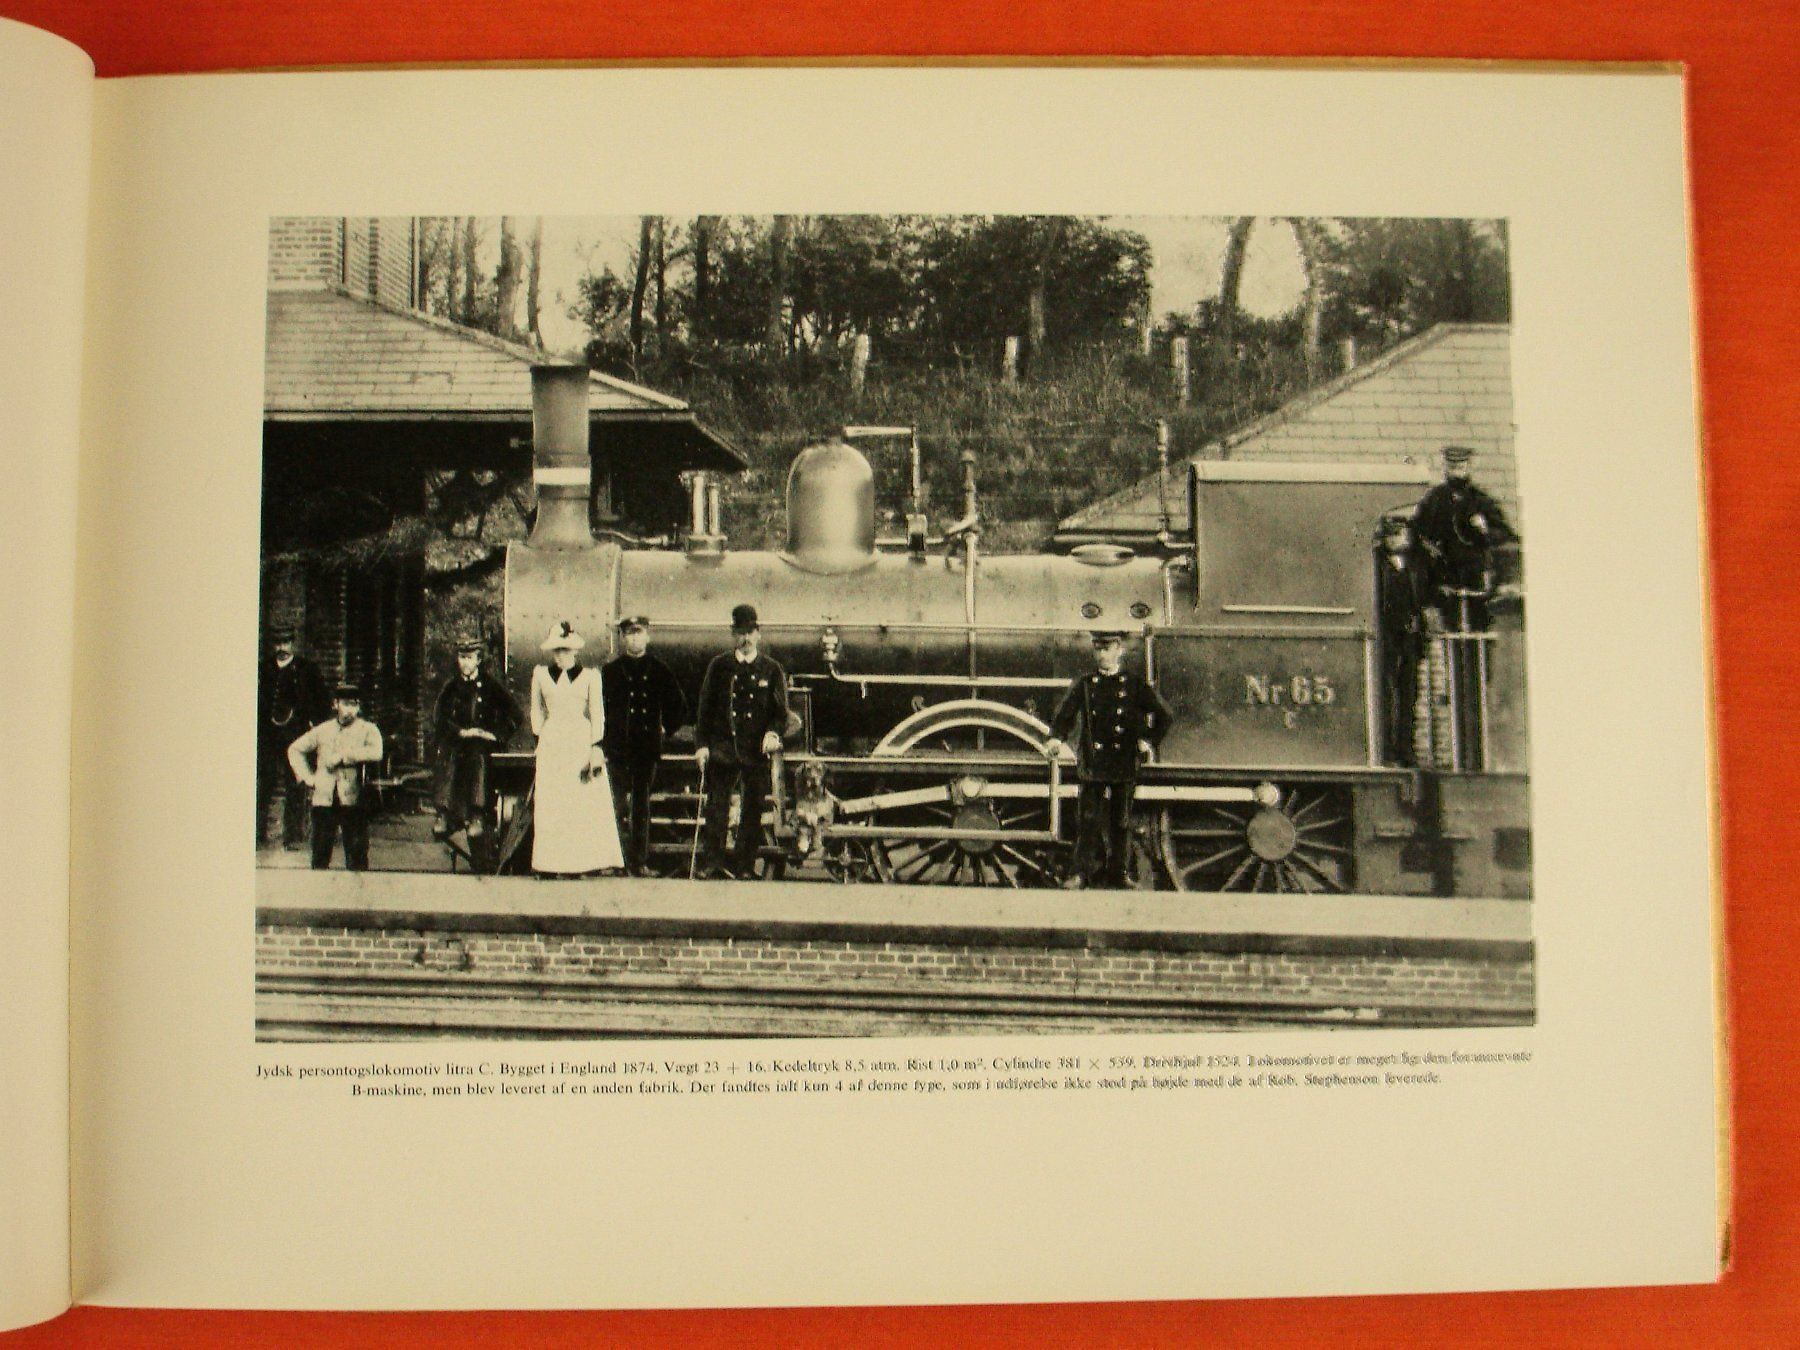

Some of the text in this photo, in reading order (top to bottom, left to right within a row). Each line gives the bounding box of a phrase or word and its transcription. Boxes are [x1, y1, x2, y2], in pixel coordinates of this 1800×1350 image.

[1245, 675, 1335, 704] Nr 65
[256, 1065, 292, 1079] Jydsk
[300, 1063, 440, 1079] persontogslokomotiv
[447, 1062, 473, 1075] litra
[479, 1063, 493, 1075] C.
[501, 1063, 544, 1078] Bygget
[551, 1062, 554, 1074] i
[561, 1061, 616, 1077] England
[624, 1062, 658, 1074] 1874.
[664, 1061, 699, 1076] Vægt
[704, 1061, 719, 1073] 23
[728, 1062, 739, 1075] +
[747, 1061, 769, 1073] 16.
[773, 1059, 840, 1075] Kedeltryk
[868, 1061, 901, 1072] atm.
[905, 1057, 935, 1072] Rist
[992, 1056, 1051, 1072] Cylindre
[353, 1072, 1442, 1096] B-maskine, men blev leveret af en anden fabrik. Der fandtes ialt kun 4 af denne type, som i udførelse ikke stod på højde med de af Rob. Stephenson leverede.
